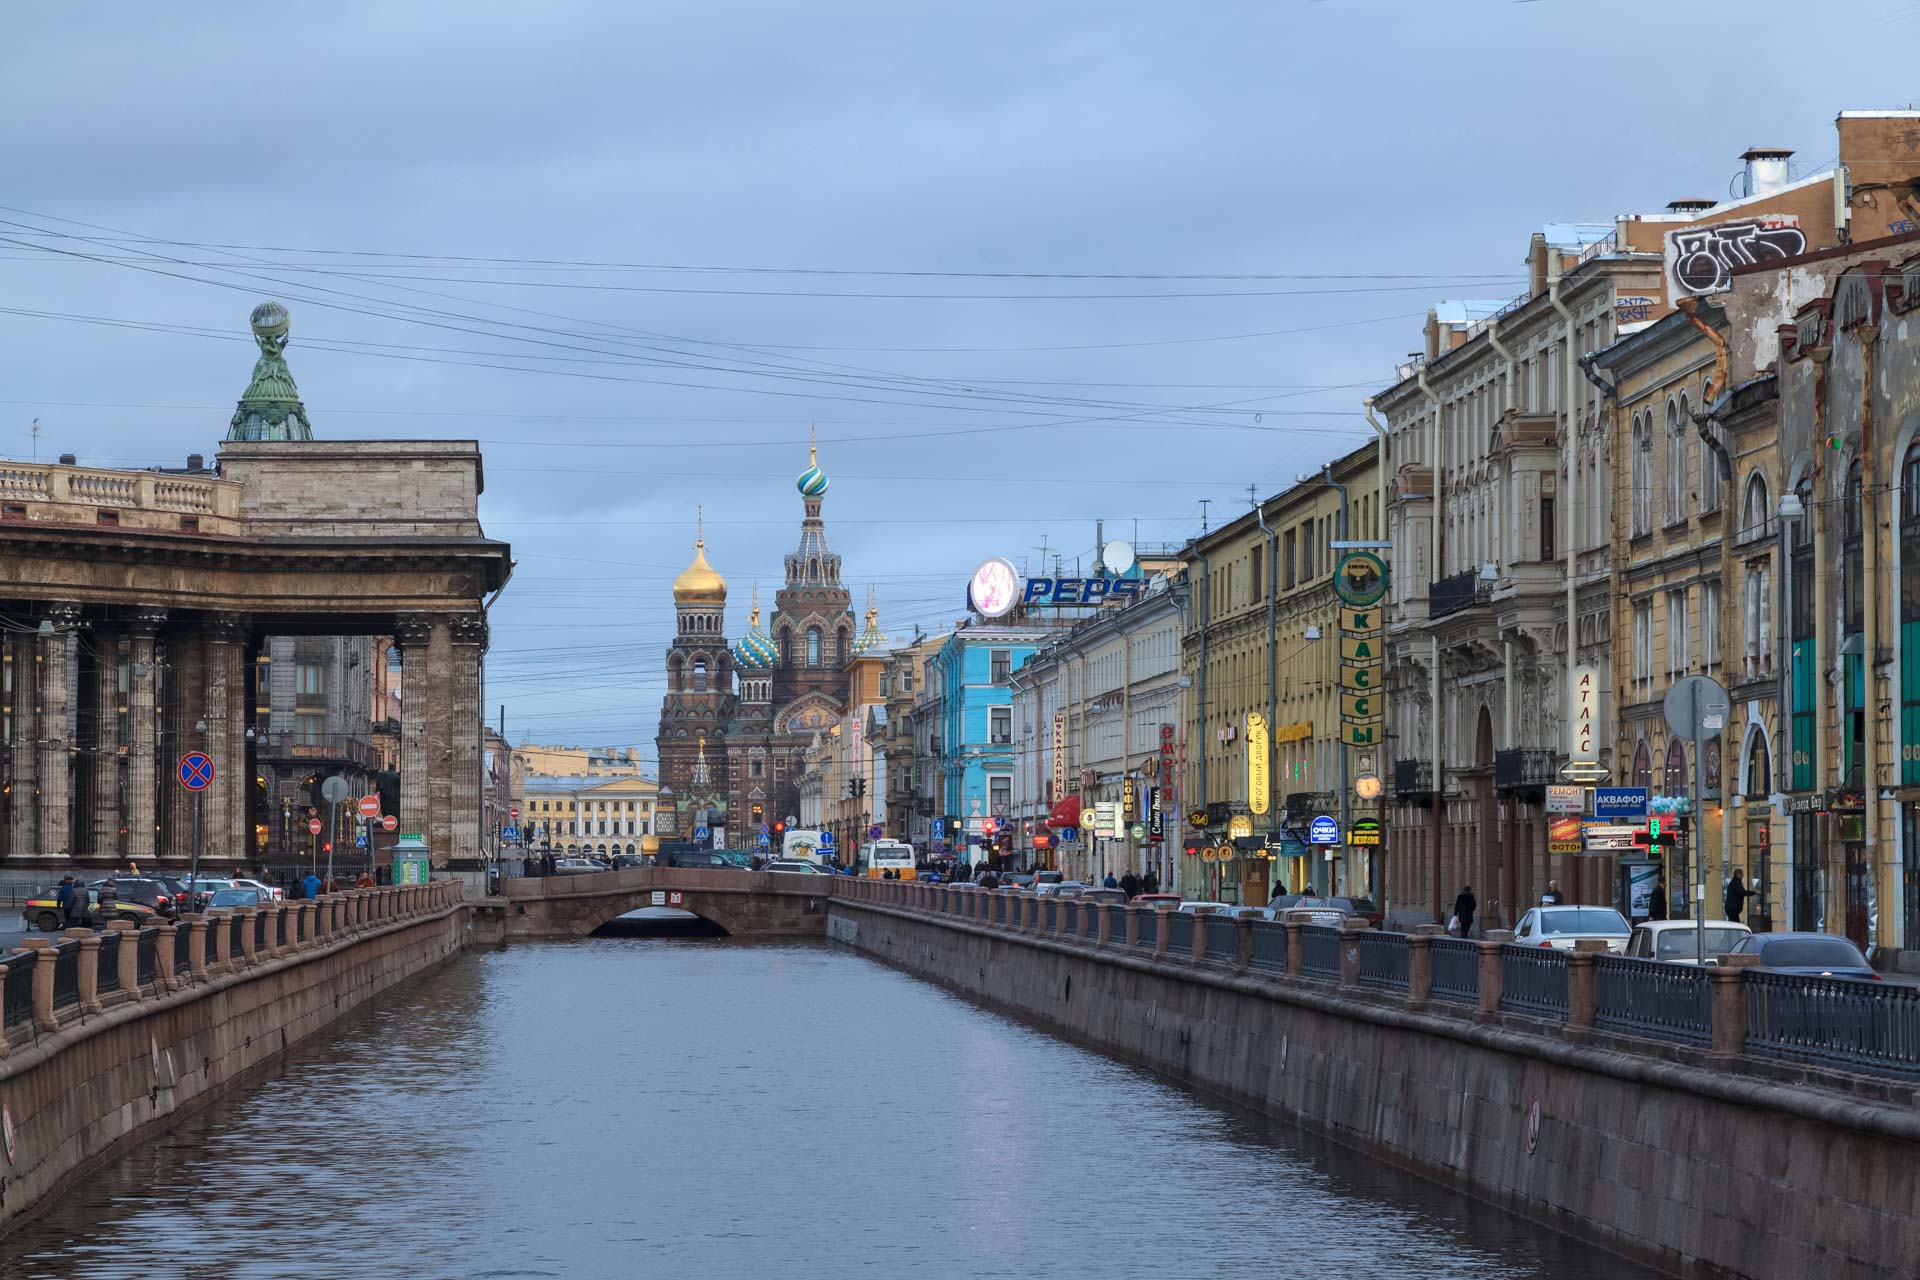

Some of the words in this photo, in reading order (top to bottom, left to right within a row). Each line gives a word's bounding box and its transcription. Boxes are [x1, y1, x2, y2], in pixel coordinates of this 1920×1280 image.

[1023, 578, 1151, 603] PEPS
[1352, 613, 1373, 743] КАССЫ
[1580, 673, 1590, 752] АТЛАС
[1549, 788, 1582, 796] РЕМОНТ
[1597, 795, 1645, 804] АКВАФОР
